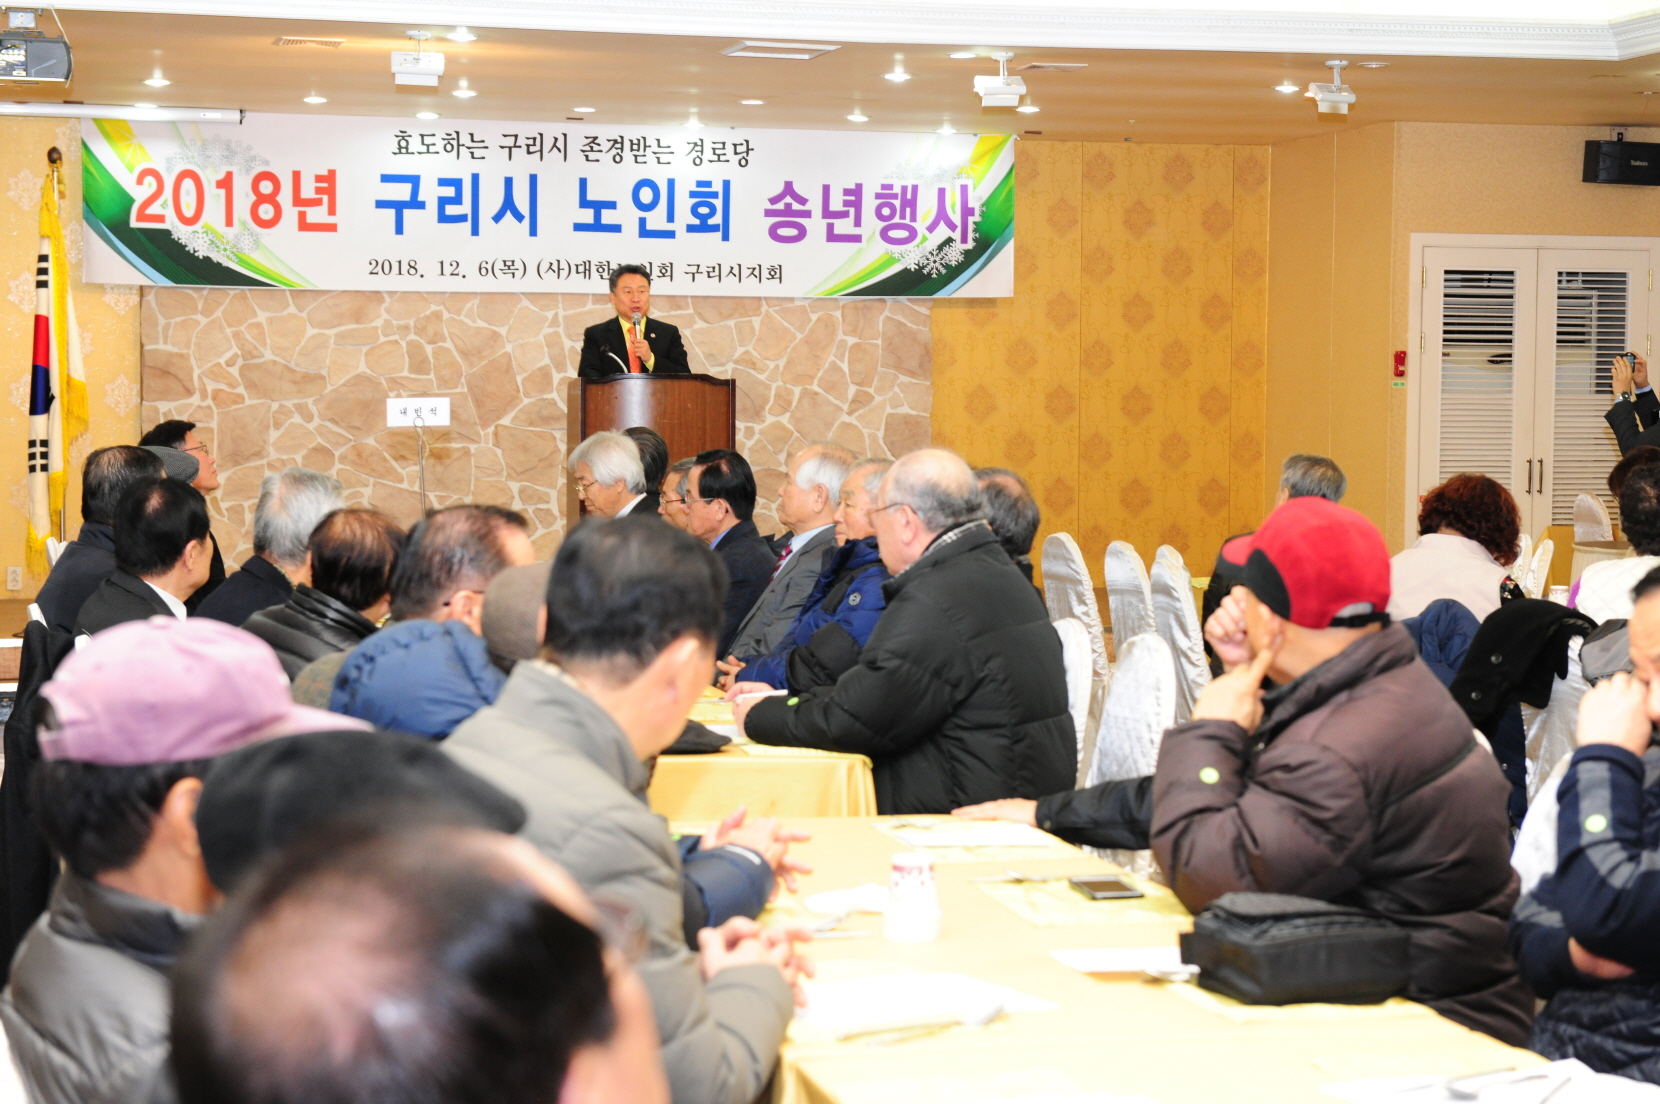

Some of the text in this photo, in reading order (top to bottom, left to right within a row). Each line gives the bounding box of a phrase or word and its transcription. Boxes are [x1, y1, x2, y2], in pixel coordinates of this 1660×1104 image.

[391, 130, 755, 168] 효도하는 구리시 존경받는 경로당
[135, 167, 976, 246] 2018년 구리시 노인회 송년행사
[368, 258, 783, 285] 2018. 12. 6(목) (사)대한회 구리시지회
